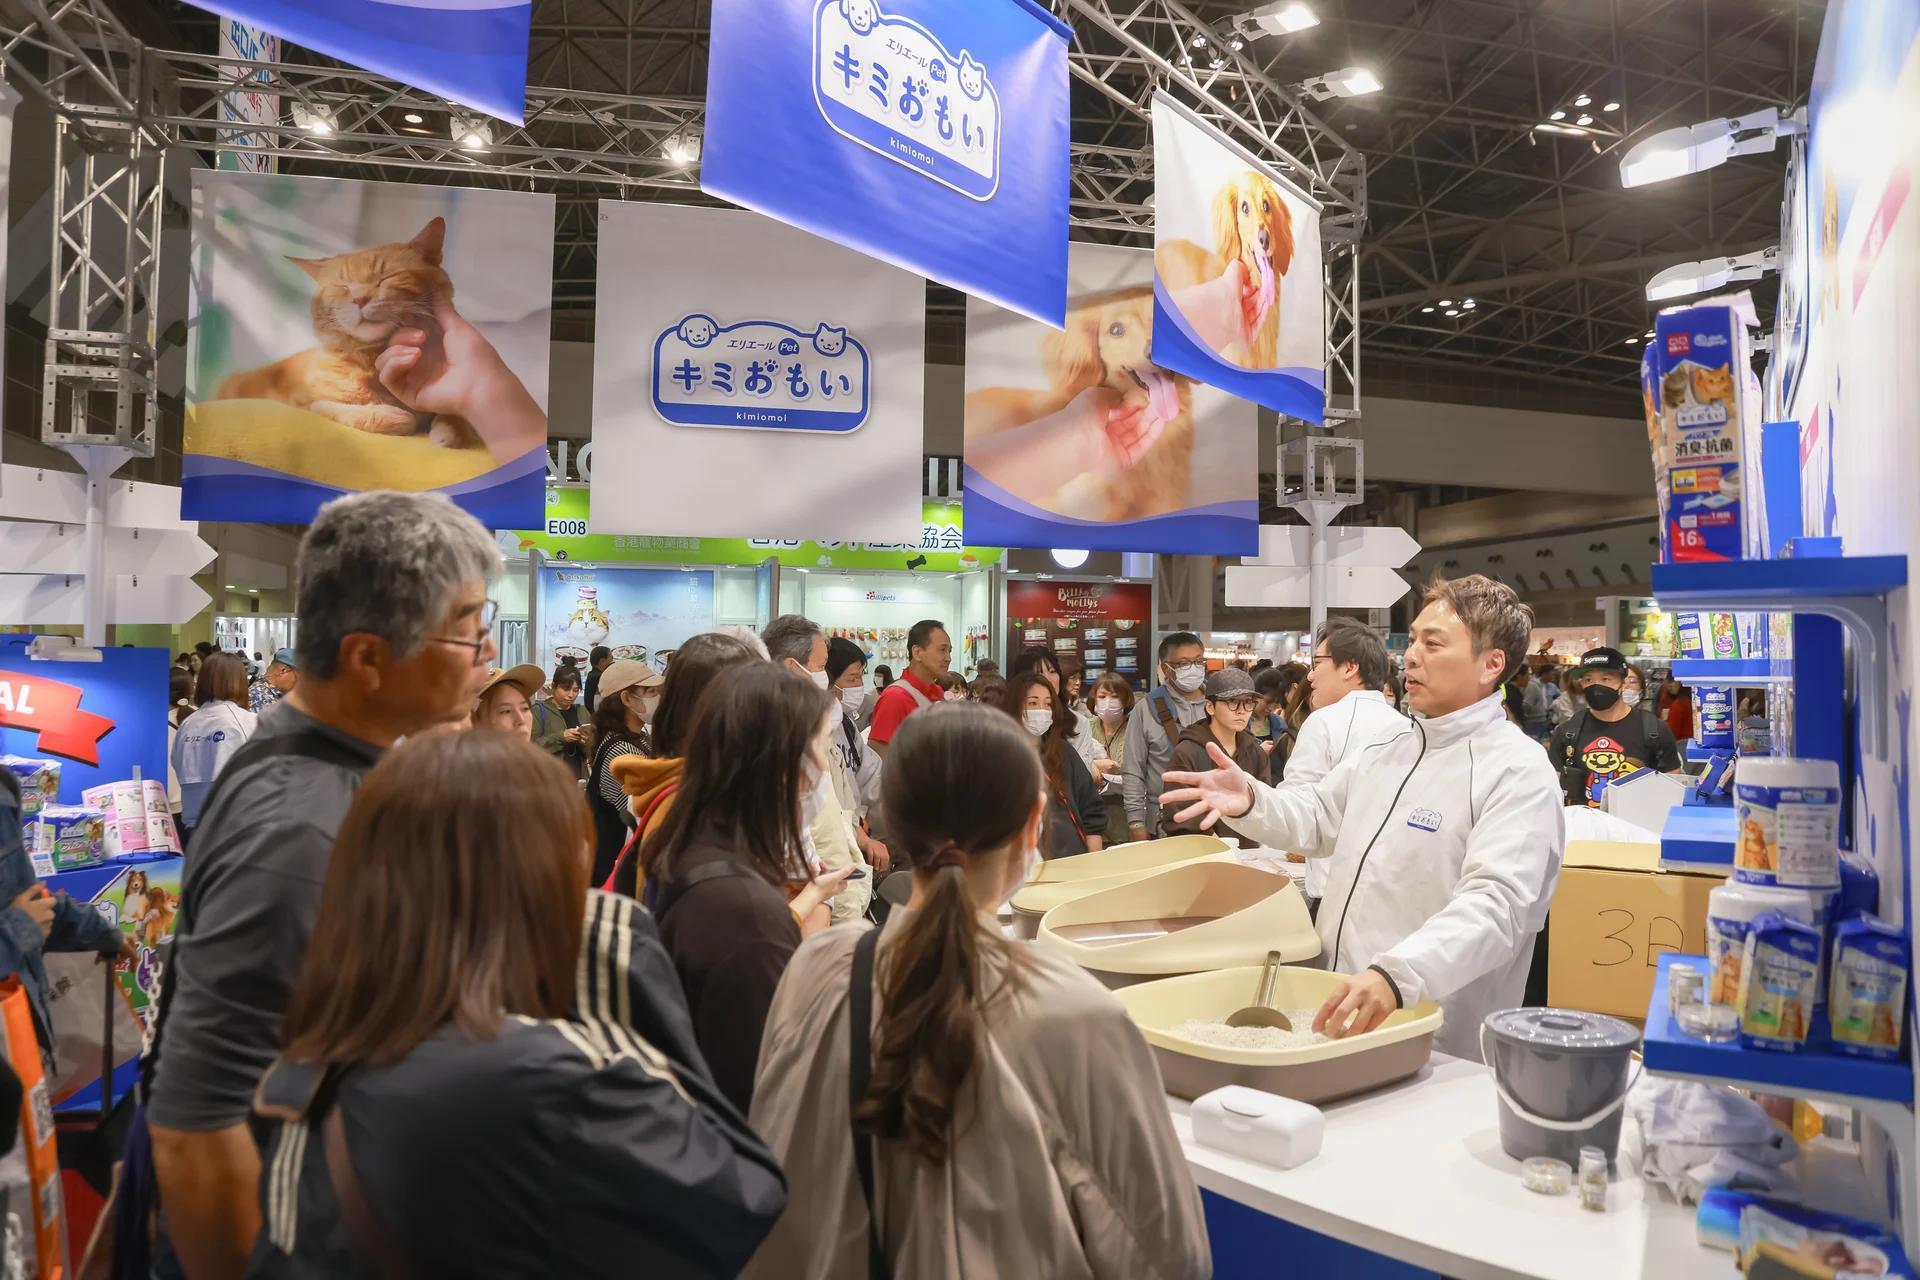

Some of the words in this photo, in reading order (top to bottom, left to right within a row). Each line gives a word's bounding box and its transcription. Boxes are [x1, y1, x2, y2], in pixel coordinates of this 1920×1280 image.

[885, 38, 928, 69] エリエール
[930, 63, 946, 79] Pet
[833, 44, 985, 148] キミおもい
[889, 136, 935, 166] kimiomoi
[727, 339, 776, 351] エリエール
[779, 341, 799, 353] Pet
[672, 358, 850, 398] キミおもい
[736, 411, 788, 422] kimiomoi
[548, 520, 587, 535] E008
[1583, 656, 1609, 664] Supreme
